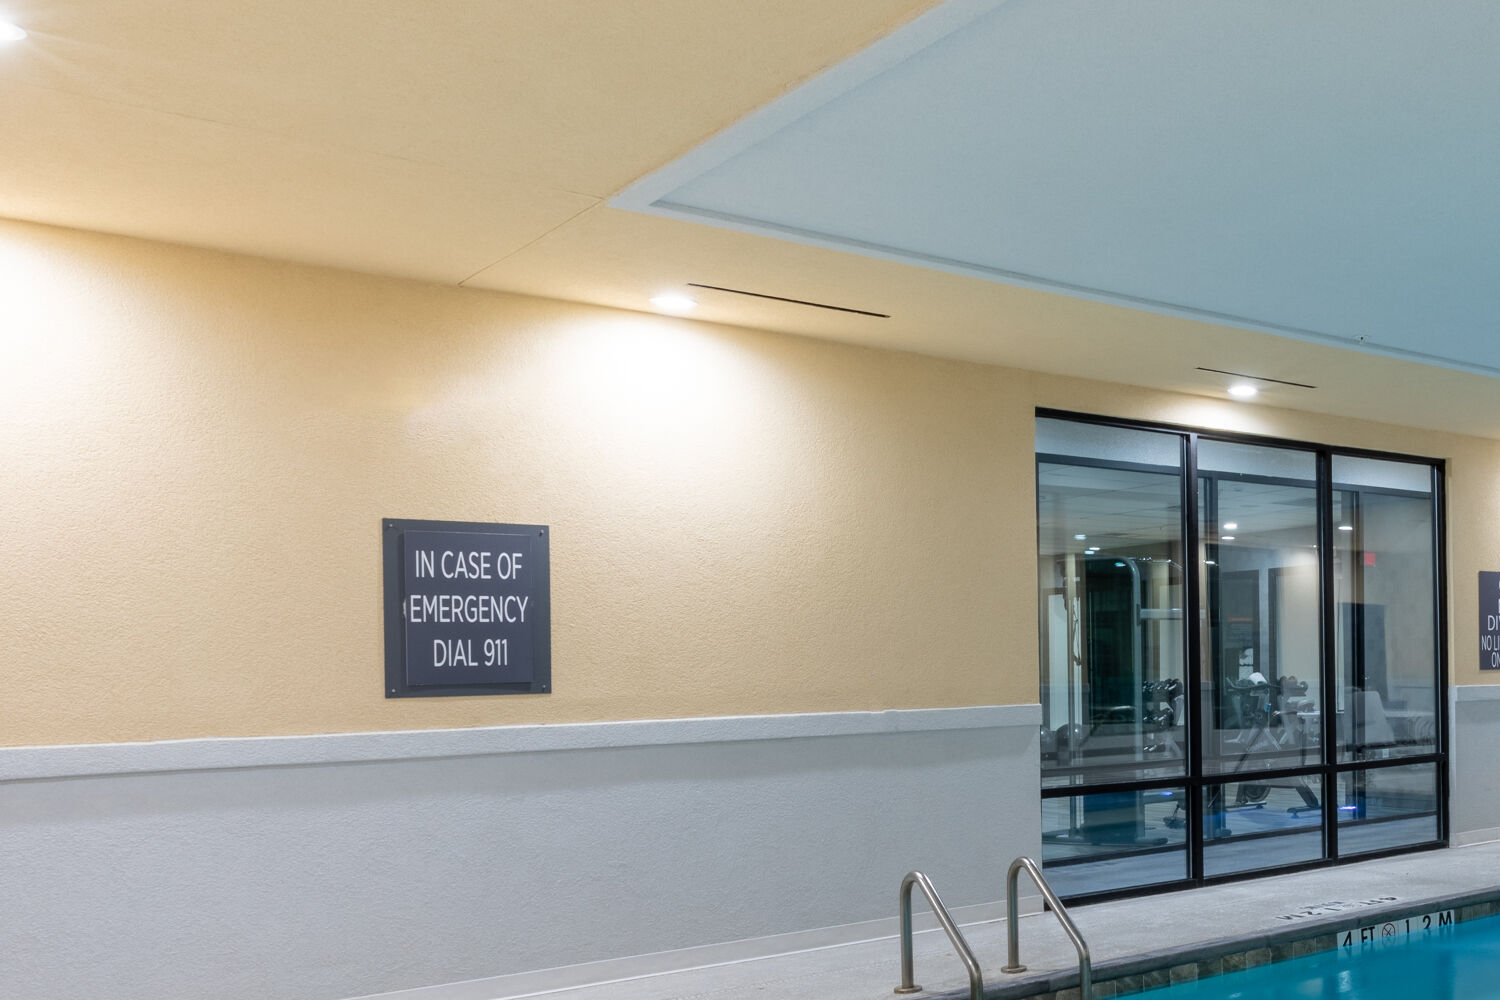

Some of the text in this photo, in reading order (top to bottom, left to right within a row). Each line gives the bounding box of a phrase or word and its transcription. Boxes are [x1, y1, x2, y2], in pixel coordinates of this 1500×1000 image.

[415, 550, 523, 580] IN CASE OF
[410, 595, 528, 623] EMERGENCY
[434, 638, 508, 667] DIAL 911
[1481, 635, 1492, 651] NO
[1343, 932, 1352, 946] 4
[1361, 926, 1375, 943] FT
[1438, 911, 1452, 926] M
